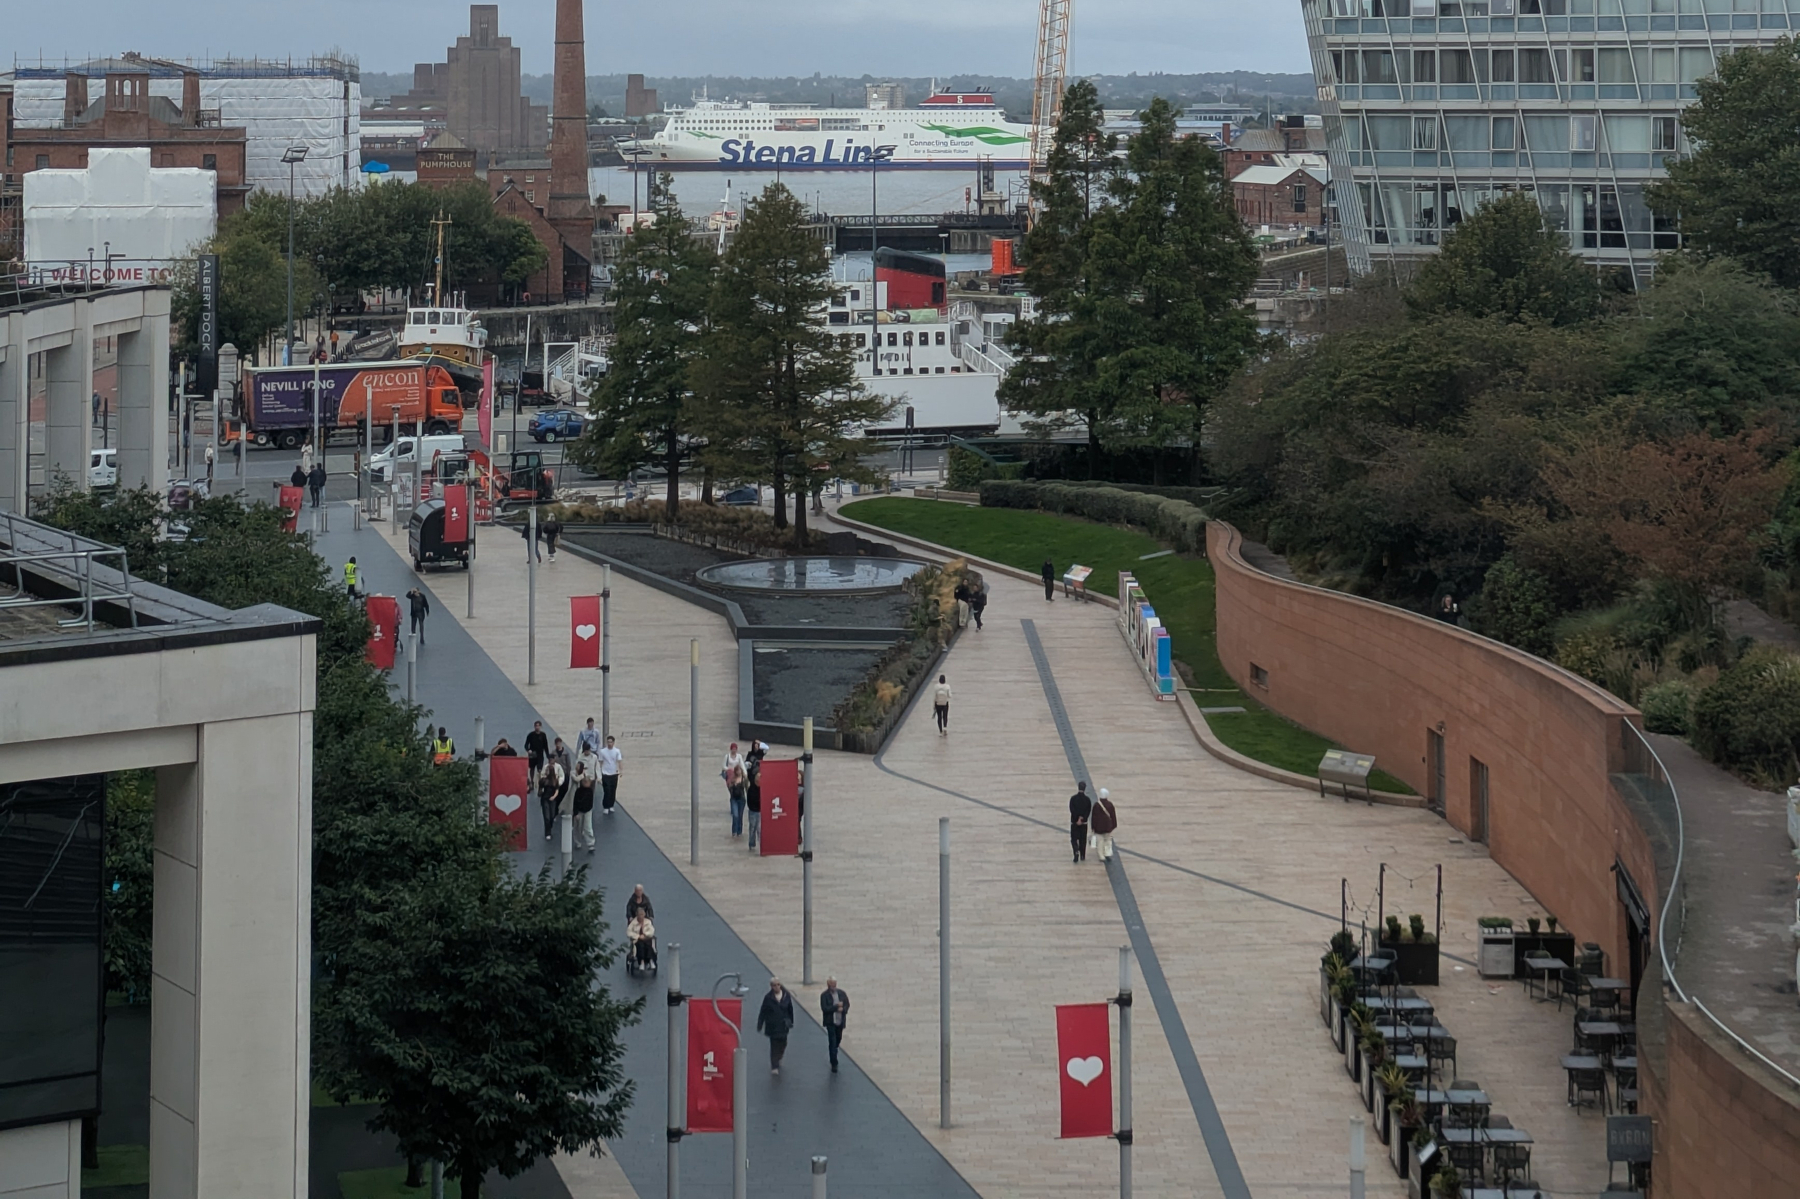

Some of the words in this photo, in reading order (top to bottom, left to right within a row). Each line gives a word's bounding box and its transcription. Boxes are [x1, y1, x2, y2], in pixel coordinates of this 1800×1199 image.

[718, 139, 815, 163] Stena
[51, 268, 143, 281] WELCOME
[202, 259, 212, 310] ALBERT
[202, 312, 211, 352] DOCK
[261, 381, 300, 392] NEVILL
[363, 371, 419, 388] encon
[1611, 1130, 1650, 1145] BYRON
